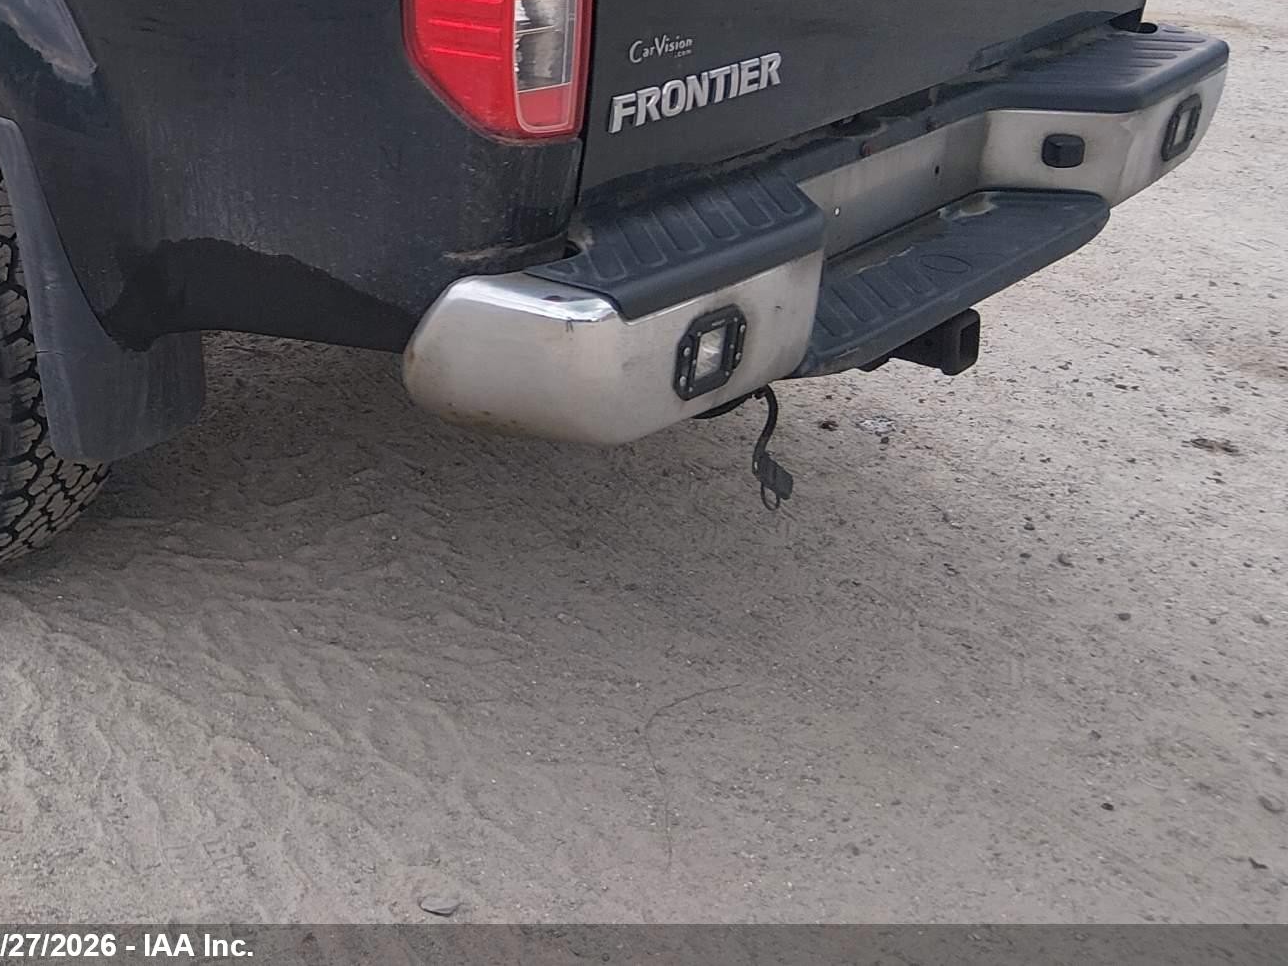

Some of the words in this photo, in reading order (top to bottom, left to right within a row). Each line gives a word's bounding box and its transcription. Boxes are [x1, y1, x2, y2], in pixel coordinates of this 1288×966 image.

[629, 35, 693, 64] CarVision
[674, 49, 692, 58] .com
[608, 52, 782, 134] FRONTIER
